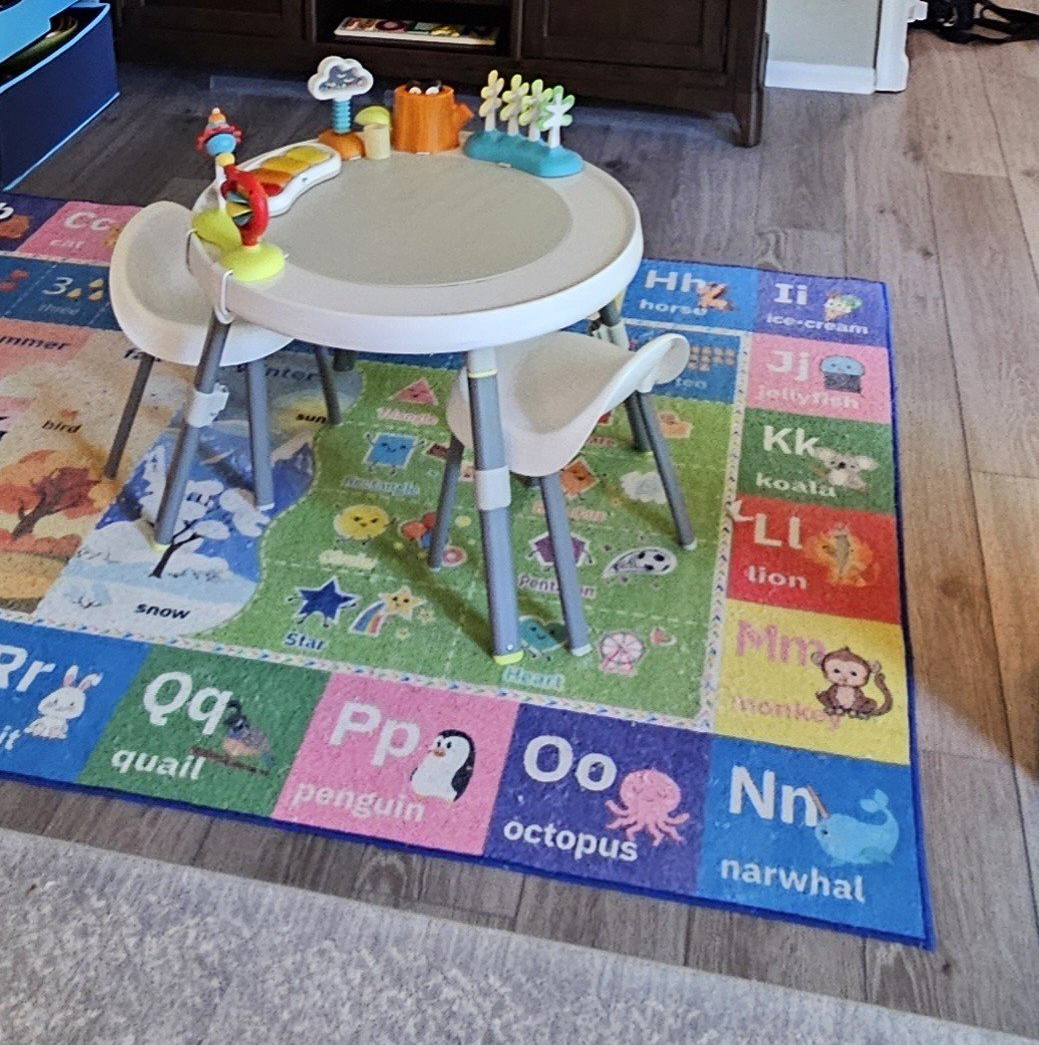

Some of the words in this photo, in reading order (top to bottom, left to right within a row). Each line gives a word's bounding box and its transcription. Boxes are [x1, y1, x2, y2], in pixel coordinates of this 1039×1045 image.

[63, 211, 112, 232] Cc
[49, 238, 83, 250] cat
[41, 276, 74, 295] 3
[644, 269, 706, 294] Hh
[773, 282, 808, 305] Ii
[639, 299, 708, 316] horse
[767, 349, 810, 382] Jj
[759, 384, 859, 410] jellyfish
[41, 419, 82, 434] bird
[296, 414, 328, 425] sun
[762, 425, 820, 457] Kk
[756, 472, 837, 498] koala
[753, 514, 803, 551] Ll
[745, 566, 808, 590] lion
[134, 601, 192, 622] snow
[284, 632, 326, 650] Star
[736, 620, 826, 666] Mm
[142, 671, 233, 735] Qq
[328, 701, 421, 766] Pp
[110, 747, 206, 782] quail
[522, 735, 618, 792] Oo
[291, 779, 426, 823] penguin
[729, 765, 818, 828] Nn
[503, 818, 639, 863] octopus
[720, 857, 866, 903] narwhal
